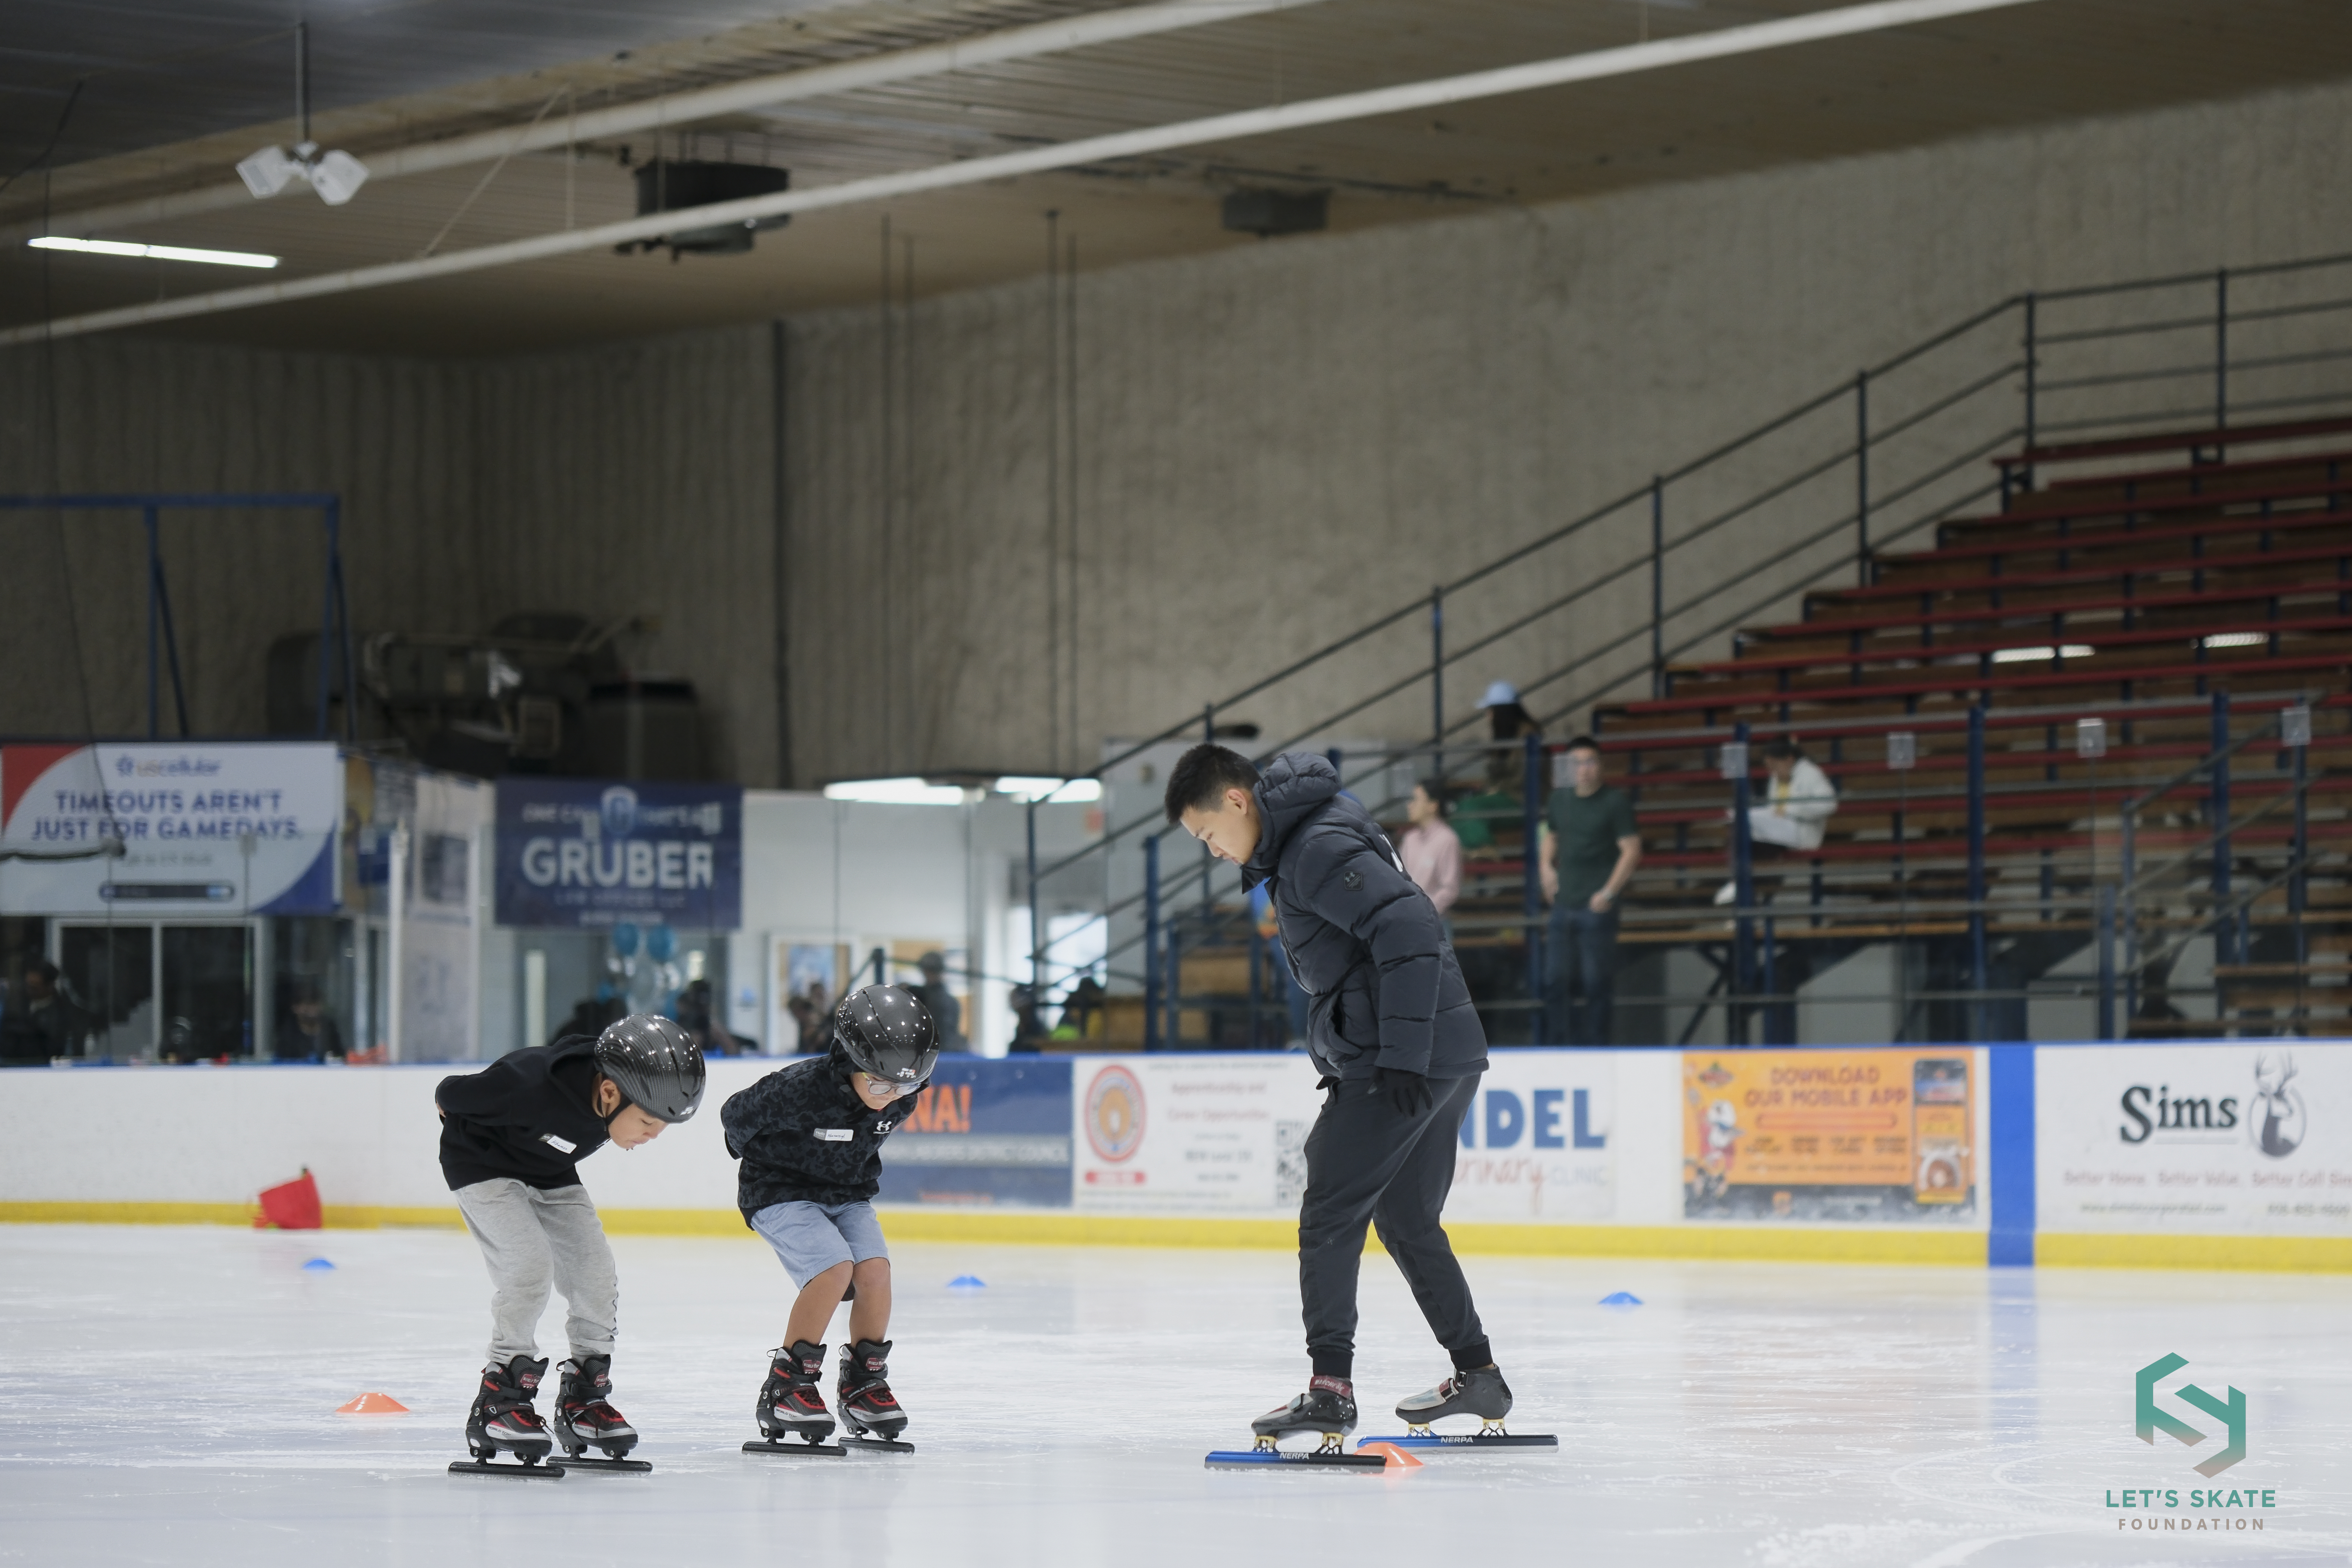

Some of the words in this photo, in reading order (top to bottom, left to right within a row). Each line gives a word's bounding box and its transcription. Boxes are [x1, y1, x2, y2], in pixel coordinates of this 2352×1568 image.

[56, 790, 183, 814] TIMEOUTS
[192, 789, 283, 813] AREN'T
[32, 819, 89, 840] JUST
[99, 819, 149, 840] FOR
[521, 837, 713, 889] GRUBER
[1770, 1066, 1881, 1085] DOWNLOAD
[899, 1083, 971, 1133] NA!
[1745, 1089, 1782, 1107] OUR
[1792, 1088, 1861, 1107] MOBILE
[1870, 1088, 1908, 1105] APP
[2120, 1082, 2238, 1146] Sims
[1552, 1166, 1609, 1185] CLINIC
